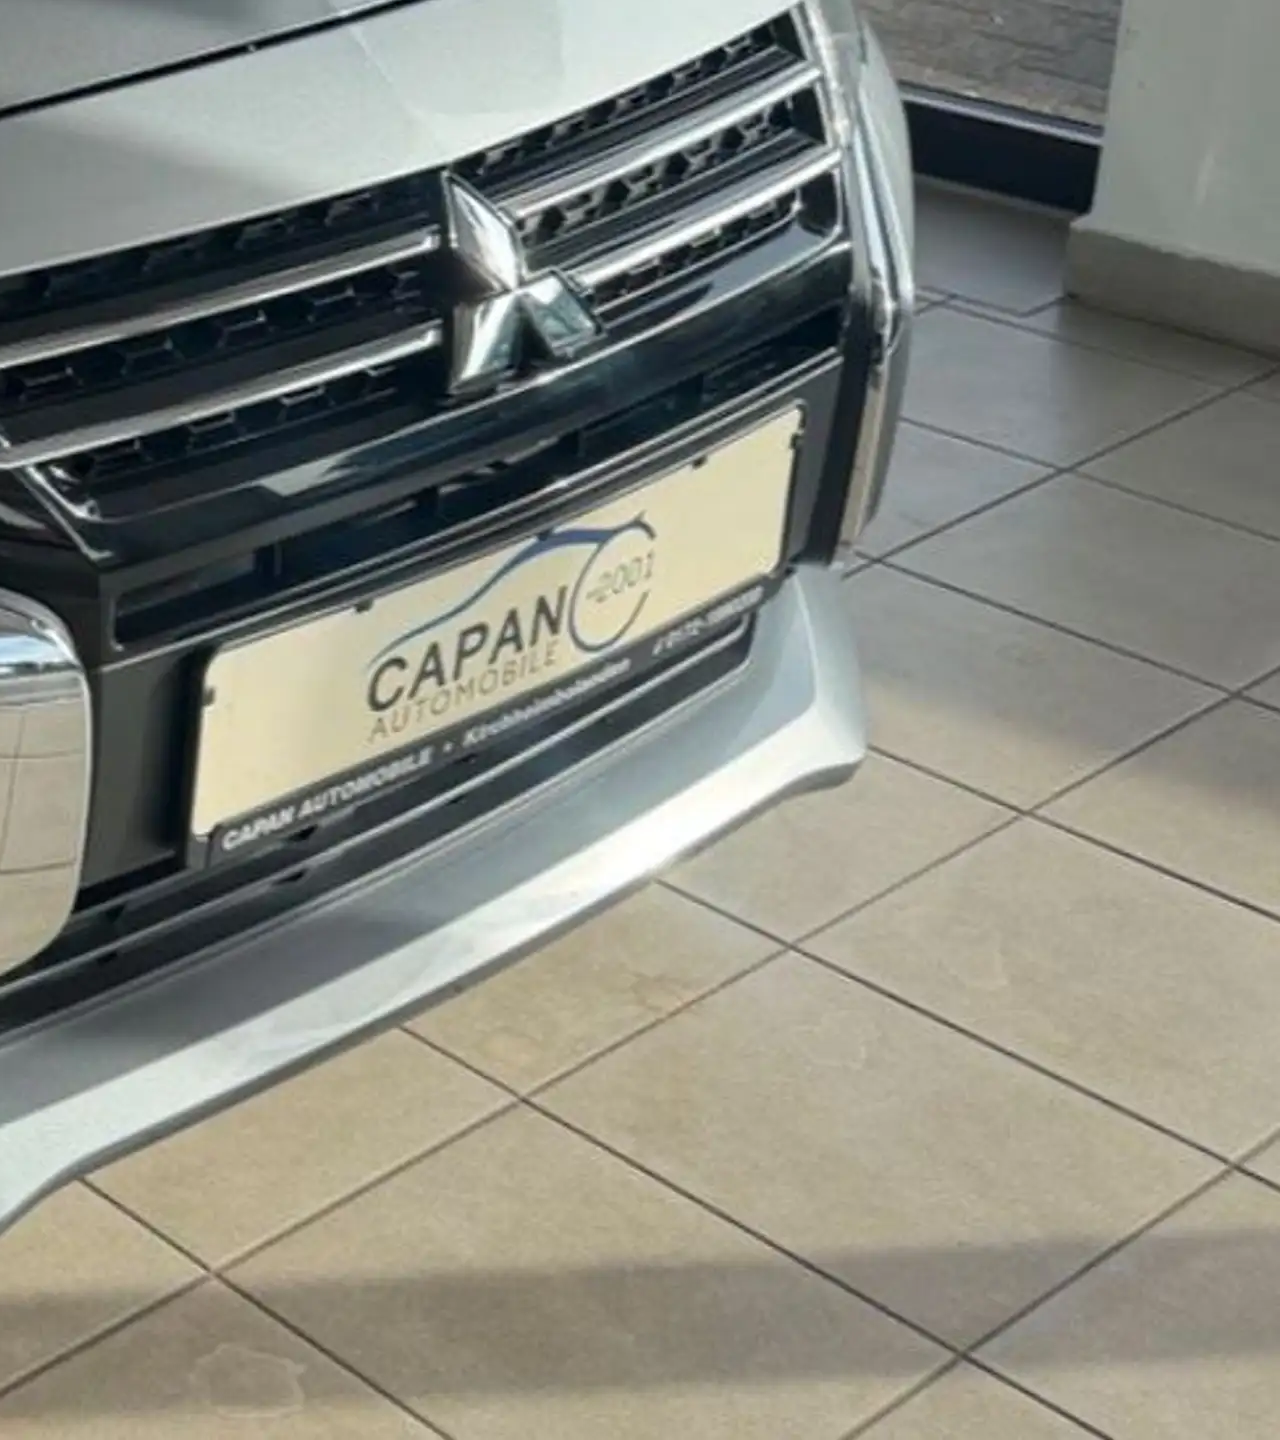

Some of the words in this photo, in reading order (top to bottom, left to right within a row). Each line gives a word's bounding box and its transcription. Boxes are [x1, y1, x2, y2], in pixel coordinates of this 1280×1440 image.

[366, 585, 569, 712] CAPAN
[367, 639, 560, 744] AUTOMOBILE
[221, 805, 296, 851] CAPAN
[296, 745, 435, 819] AUTOMOBILE
